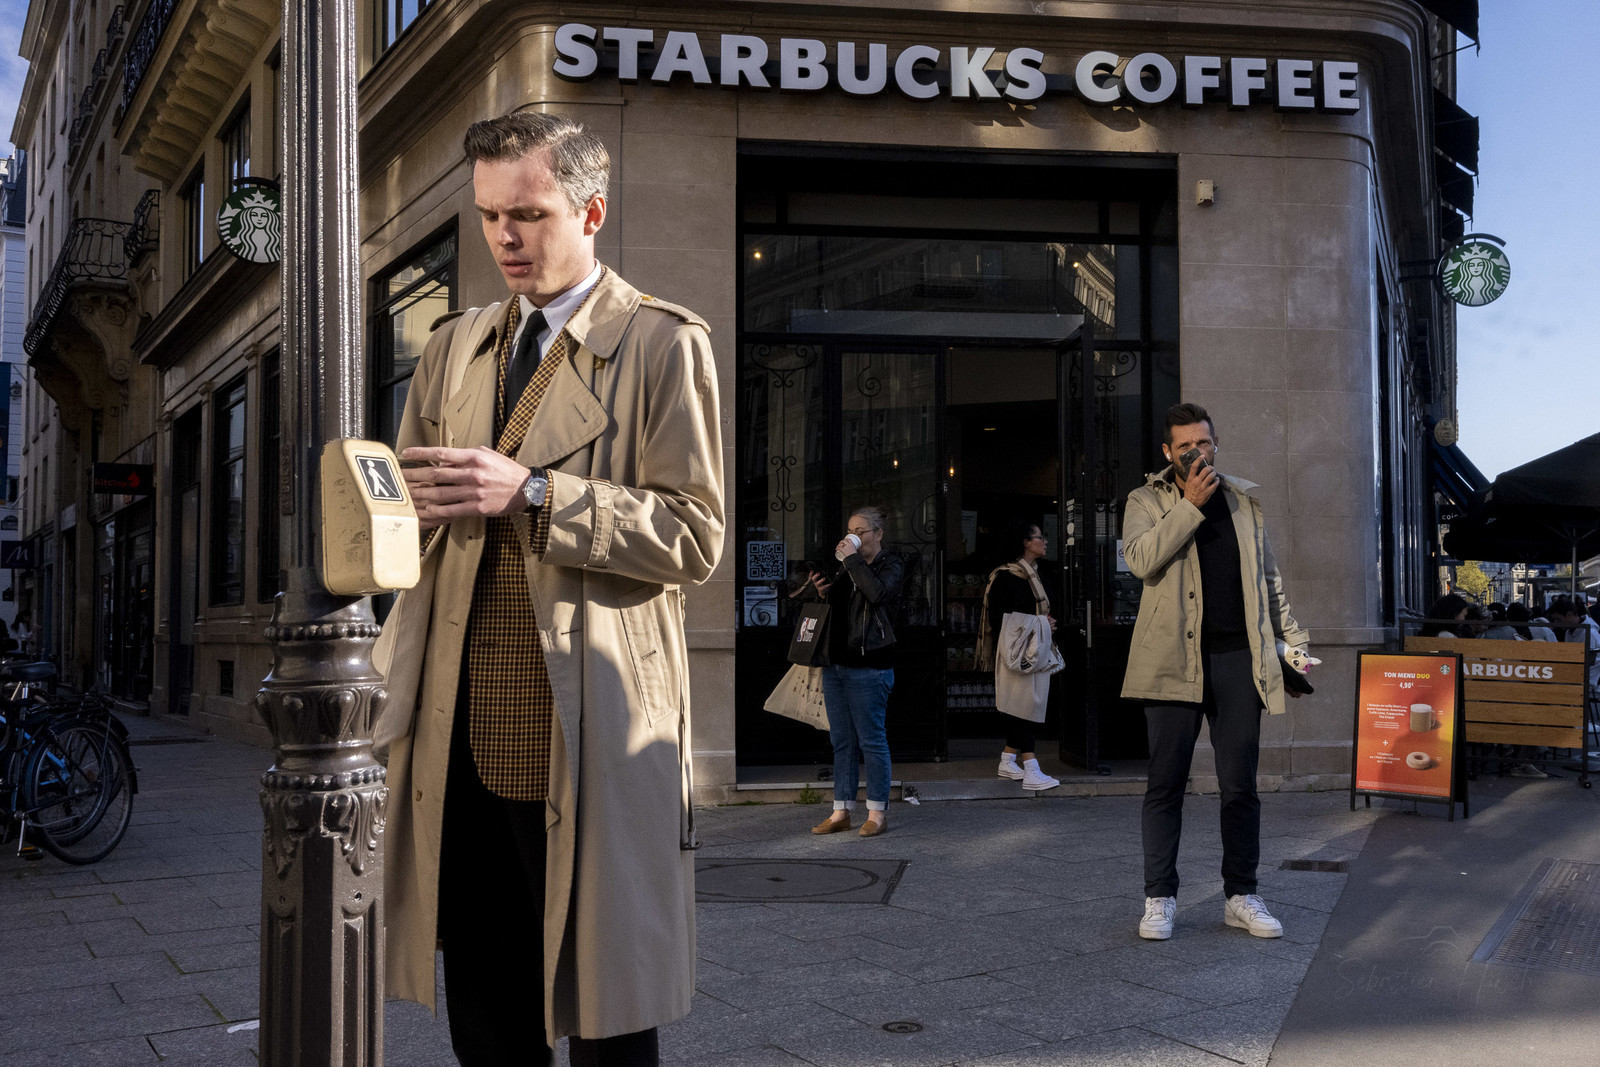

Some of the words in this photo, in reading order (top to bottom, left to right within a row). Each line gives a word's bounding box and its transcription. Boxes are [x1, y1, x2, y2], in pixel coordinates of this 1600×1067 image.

[553, 23, 1047, 99] STARBUCKS
[1075, 50, 1360, 110] COFFEE
[1463, 663, 1553, 679] ARBUCKS
